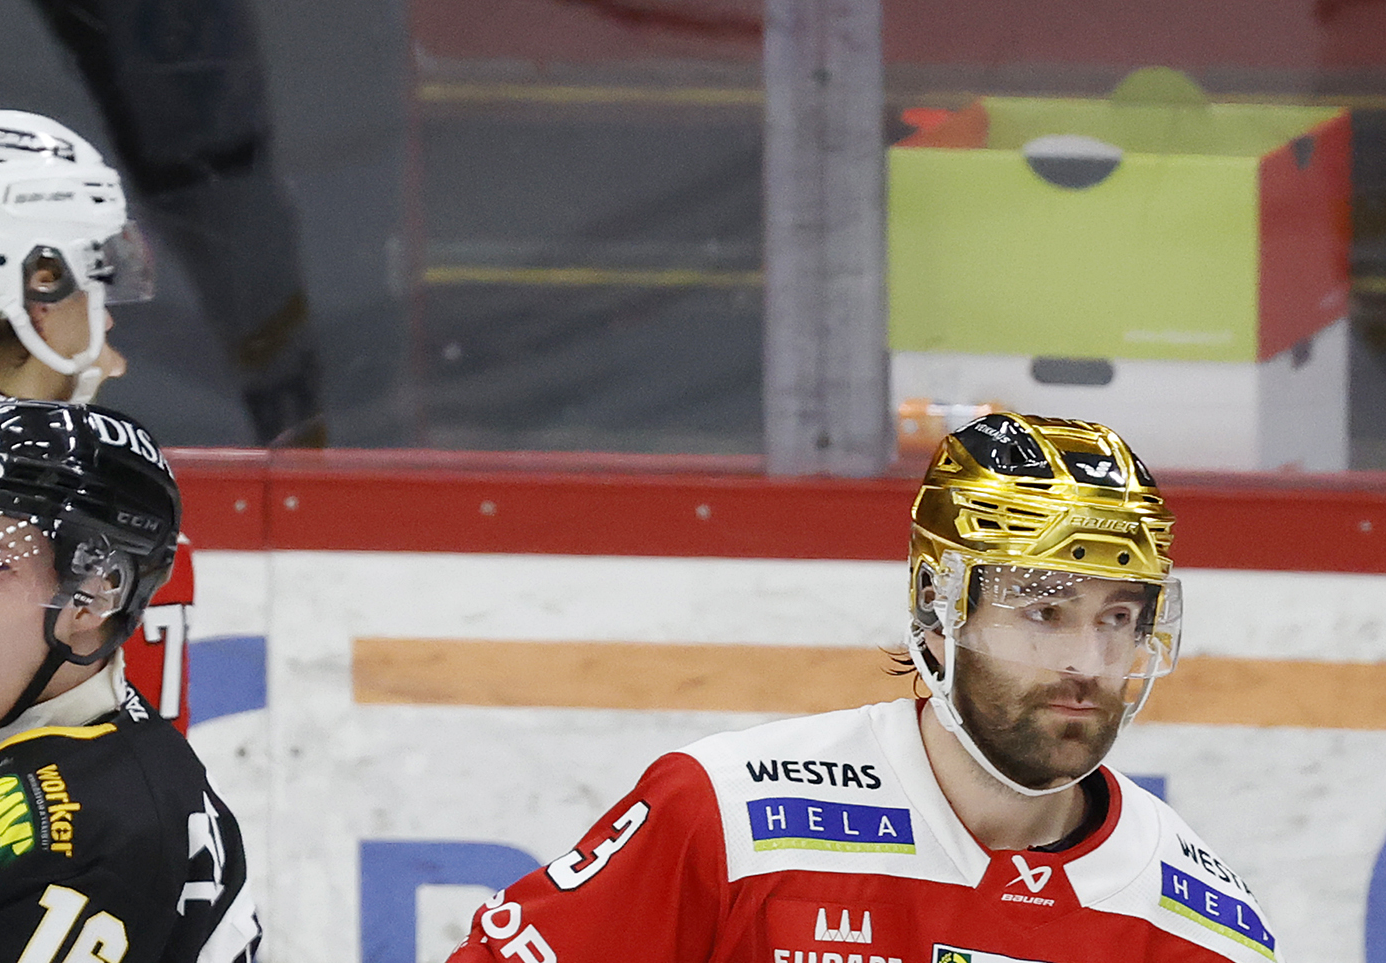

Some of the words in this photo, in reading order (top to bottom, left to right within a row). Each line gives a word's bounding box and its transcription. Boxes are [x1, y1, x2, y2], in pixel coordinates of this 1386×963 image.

[746, 759, 882, 790] WESTAS
[35, 763, 82, 858] worker
[765, 805, 898, 838] HELA
[1000, 892, 1055, 908] BAUER
